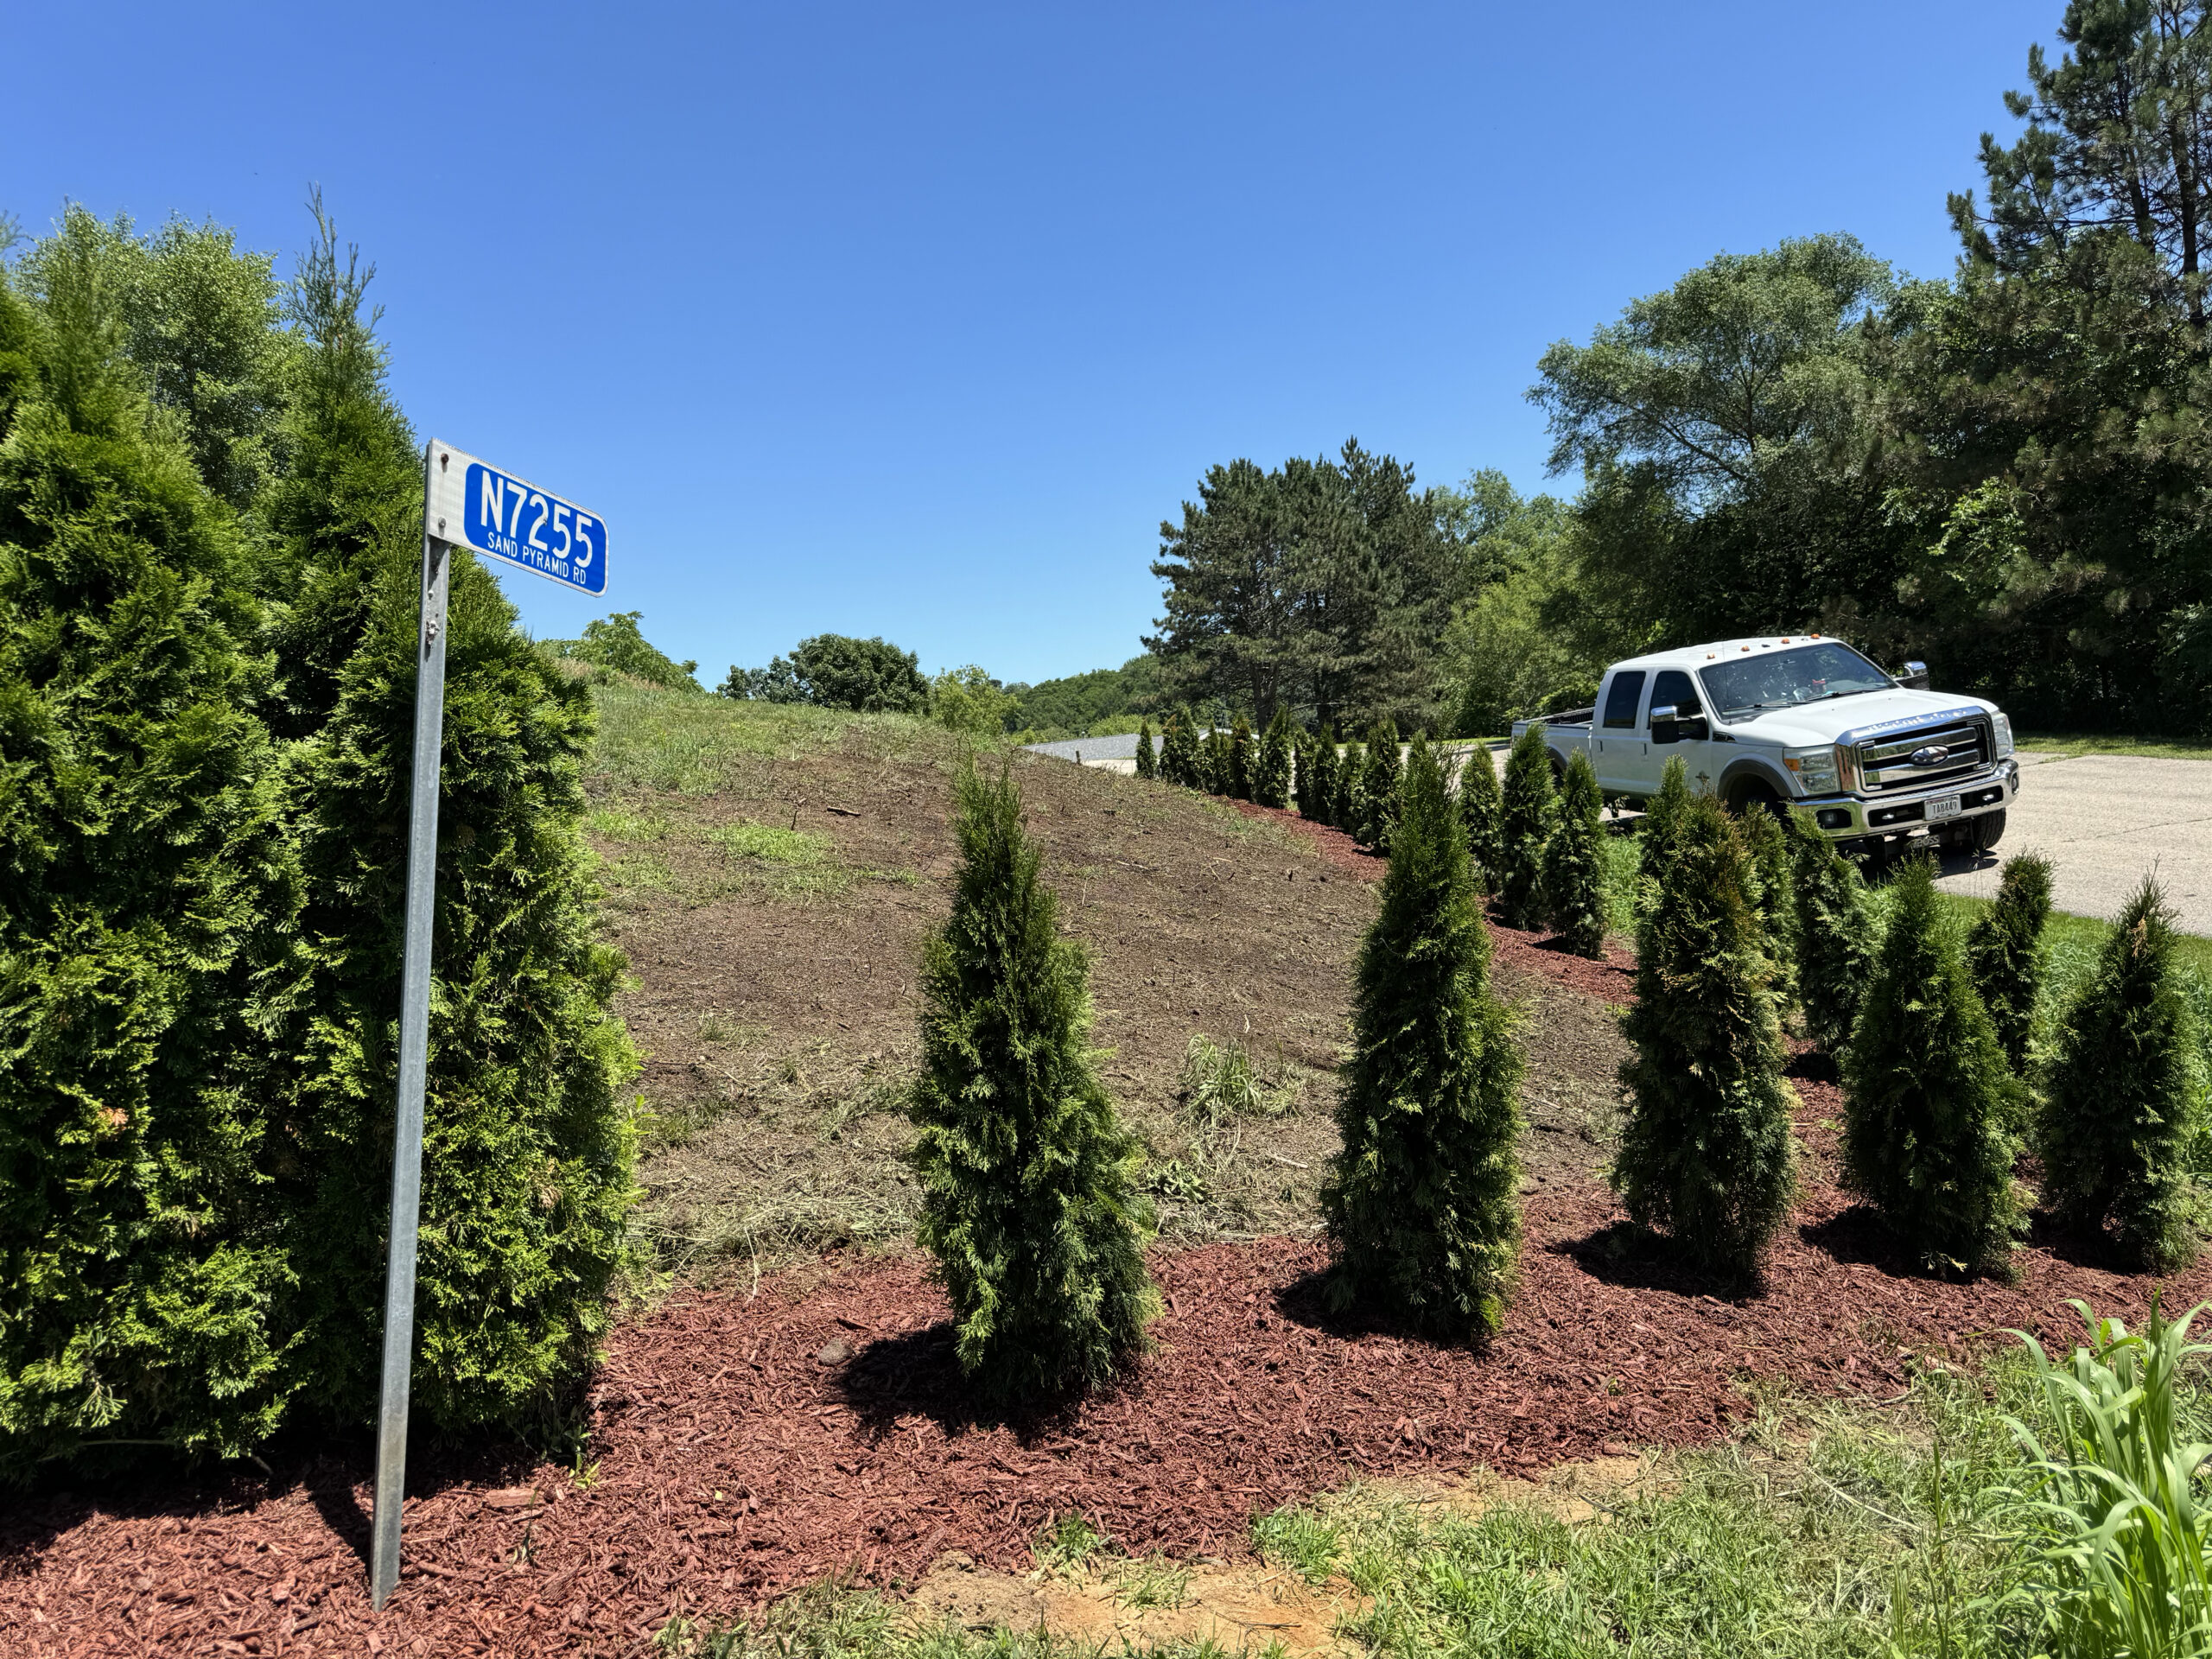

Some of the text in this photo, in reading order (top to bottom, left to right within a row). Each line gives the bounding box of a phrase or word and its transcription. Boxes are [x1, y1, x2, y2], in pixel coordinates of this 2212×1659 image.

[480, 470, 593, 568] N7255
[487, 531, 587, 585] SAND PYRAMID RD
